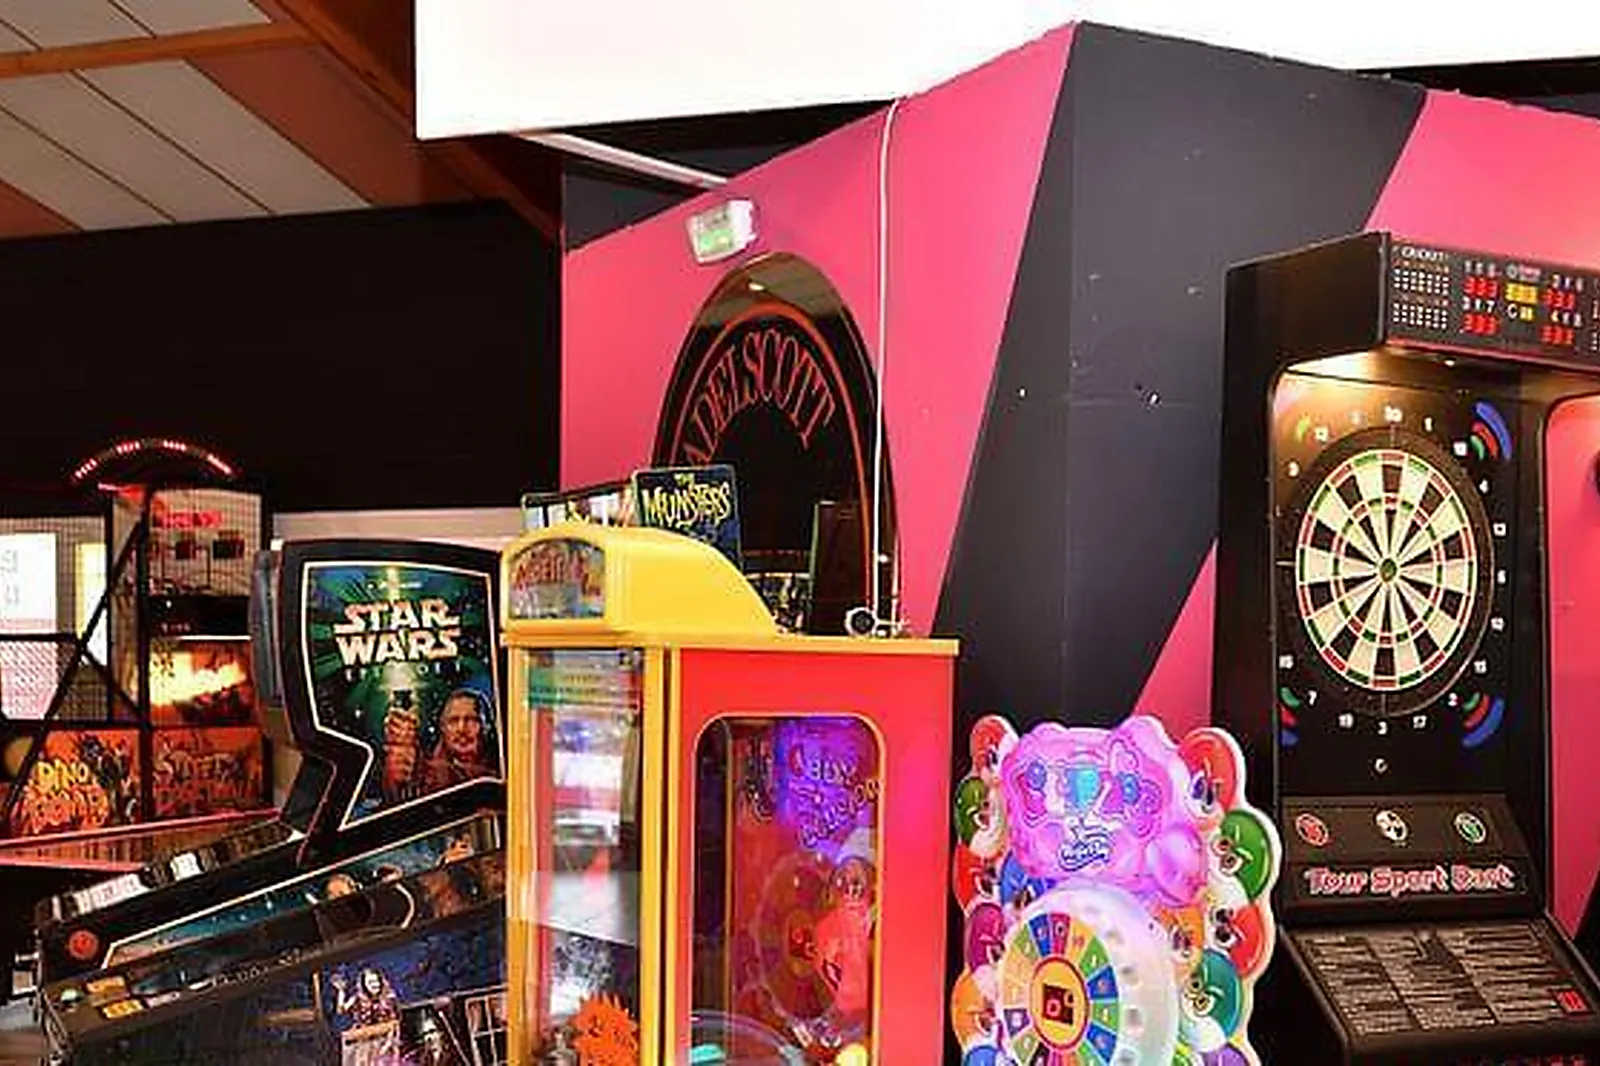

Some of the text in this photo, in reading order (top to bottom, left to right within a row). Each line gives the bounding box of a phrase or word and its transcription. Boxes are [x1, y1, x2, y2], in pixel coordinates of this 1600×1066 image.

[333, 597, 461, 634] STAR
[335, 626, 461, 666] WARS
[1308, 690, 1317, 705] 7
[1377, 721, 1387, 735] 3
[36, 758, 89, 791] DINO
